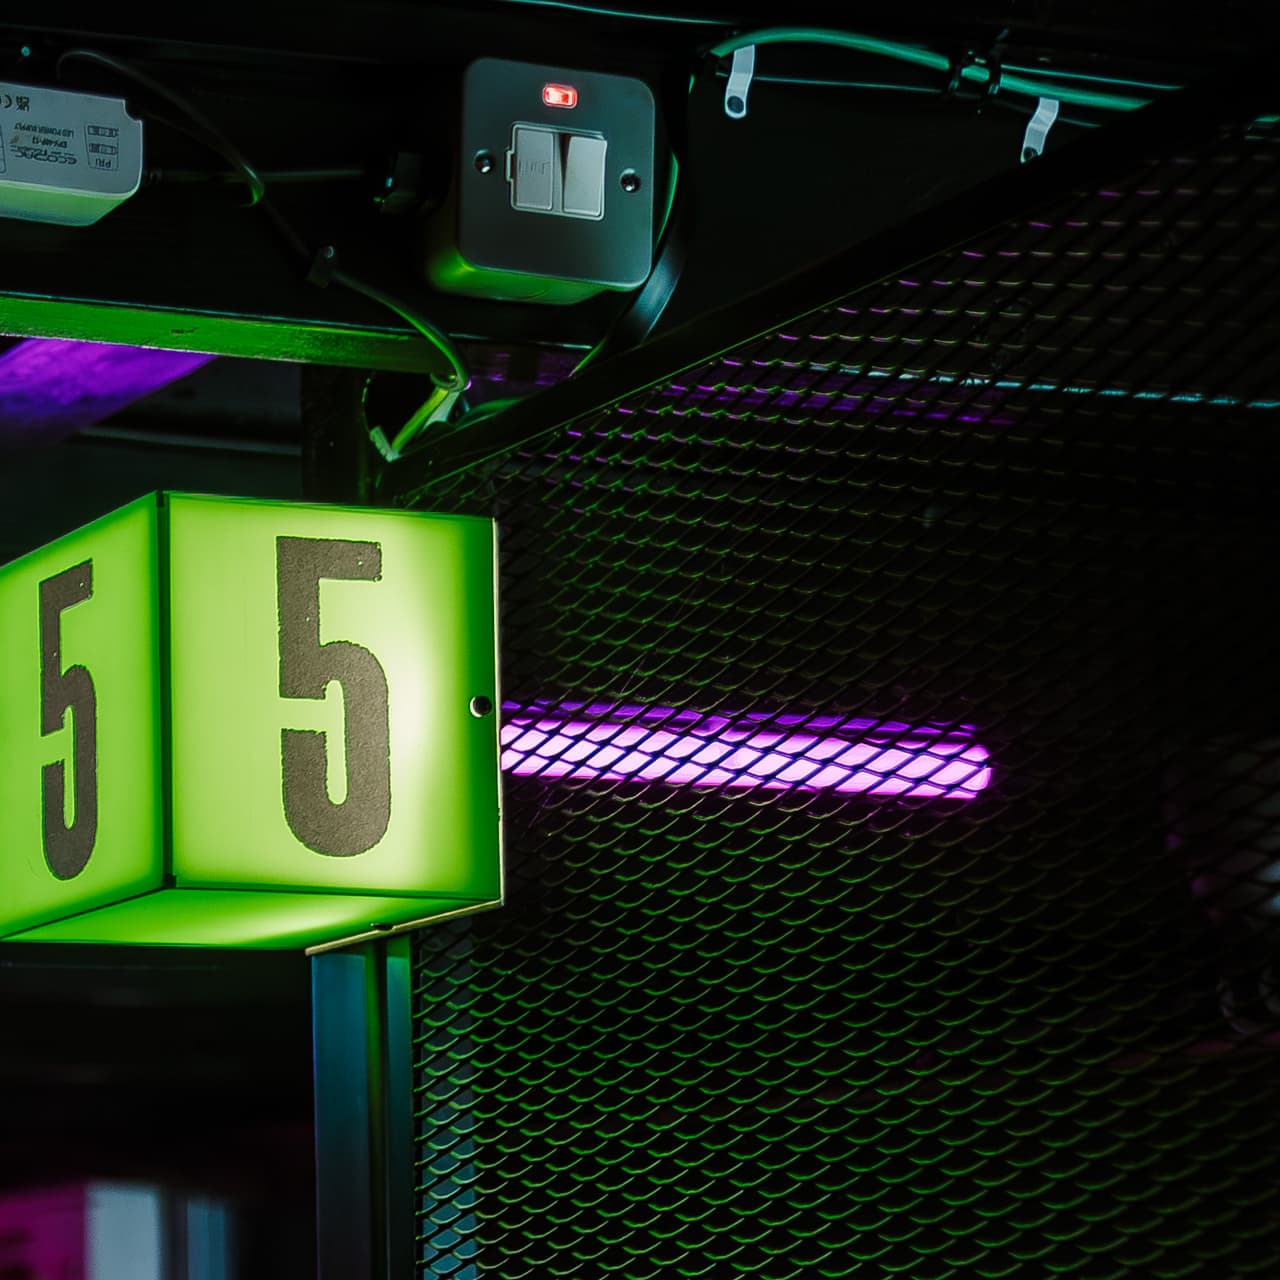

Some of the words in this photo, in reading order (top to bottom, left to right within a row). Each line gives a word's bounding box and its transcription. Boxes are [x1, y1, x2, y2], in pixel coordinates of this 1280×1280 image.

[95, 158, 111, 168] PRI
[39, 557, 98, 880] 5
[276, 535, 392, 857] 5
